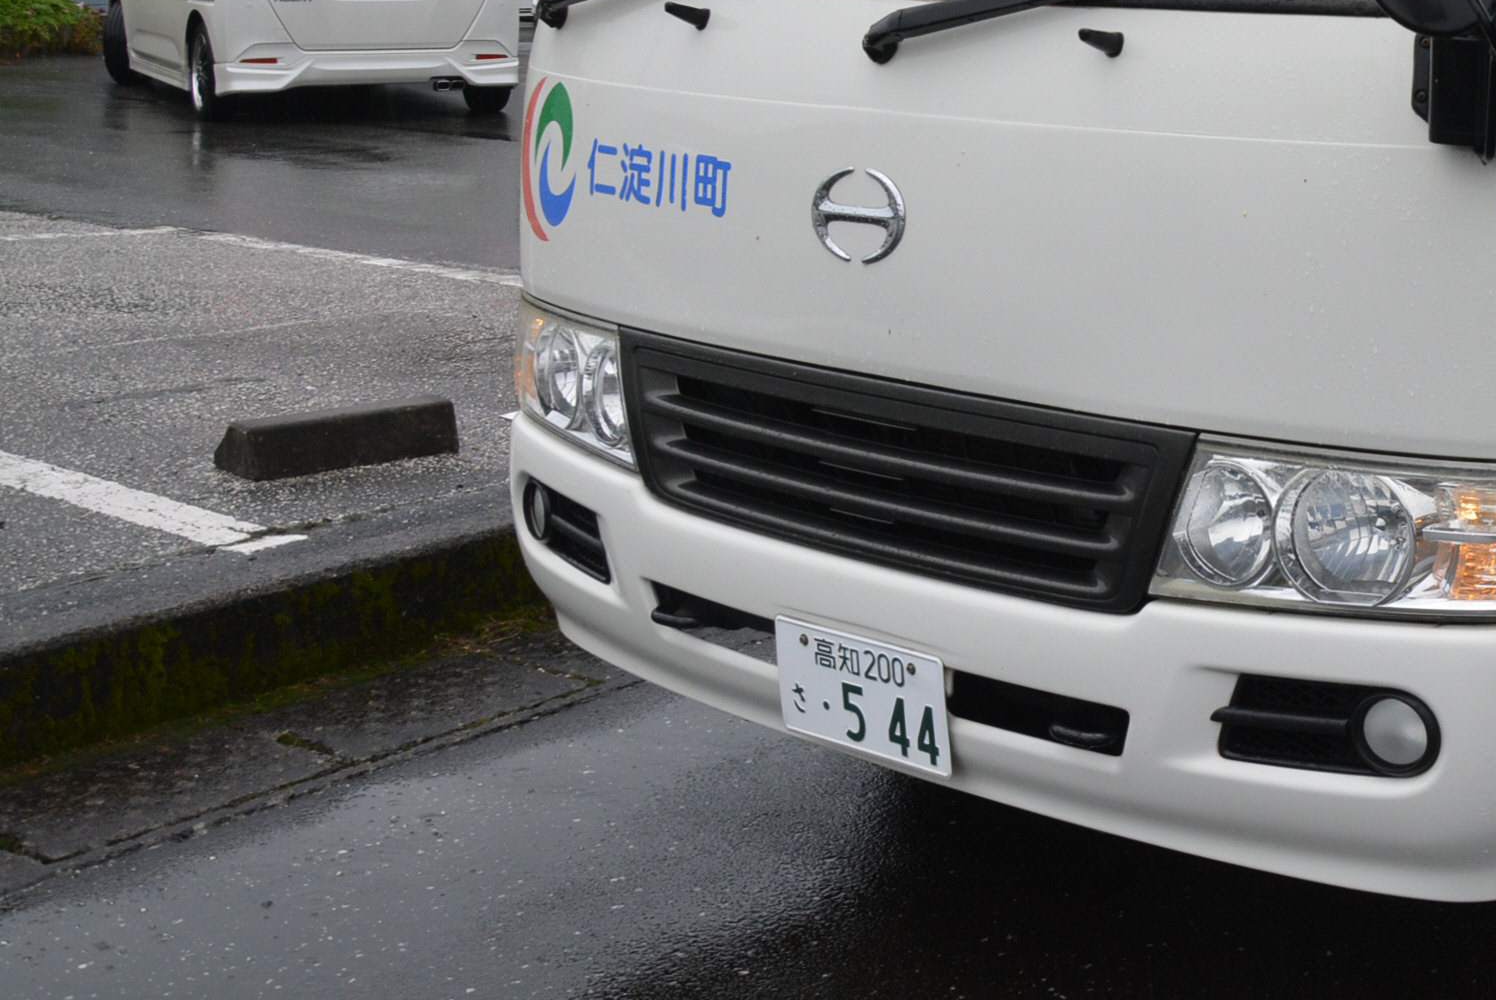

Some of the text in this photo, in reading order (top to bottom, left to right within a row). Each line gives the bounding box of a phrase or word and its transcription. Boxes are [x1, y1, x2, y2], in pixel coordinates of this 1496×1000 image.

[587, 138, 733, 218] 仁淀川町
[814, 637, 906, 688] 高知200
[791, 682, 807, 714] さ
